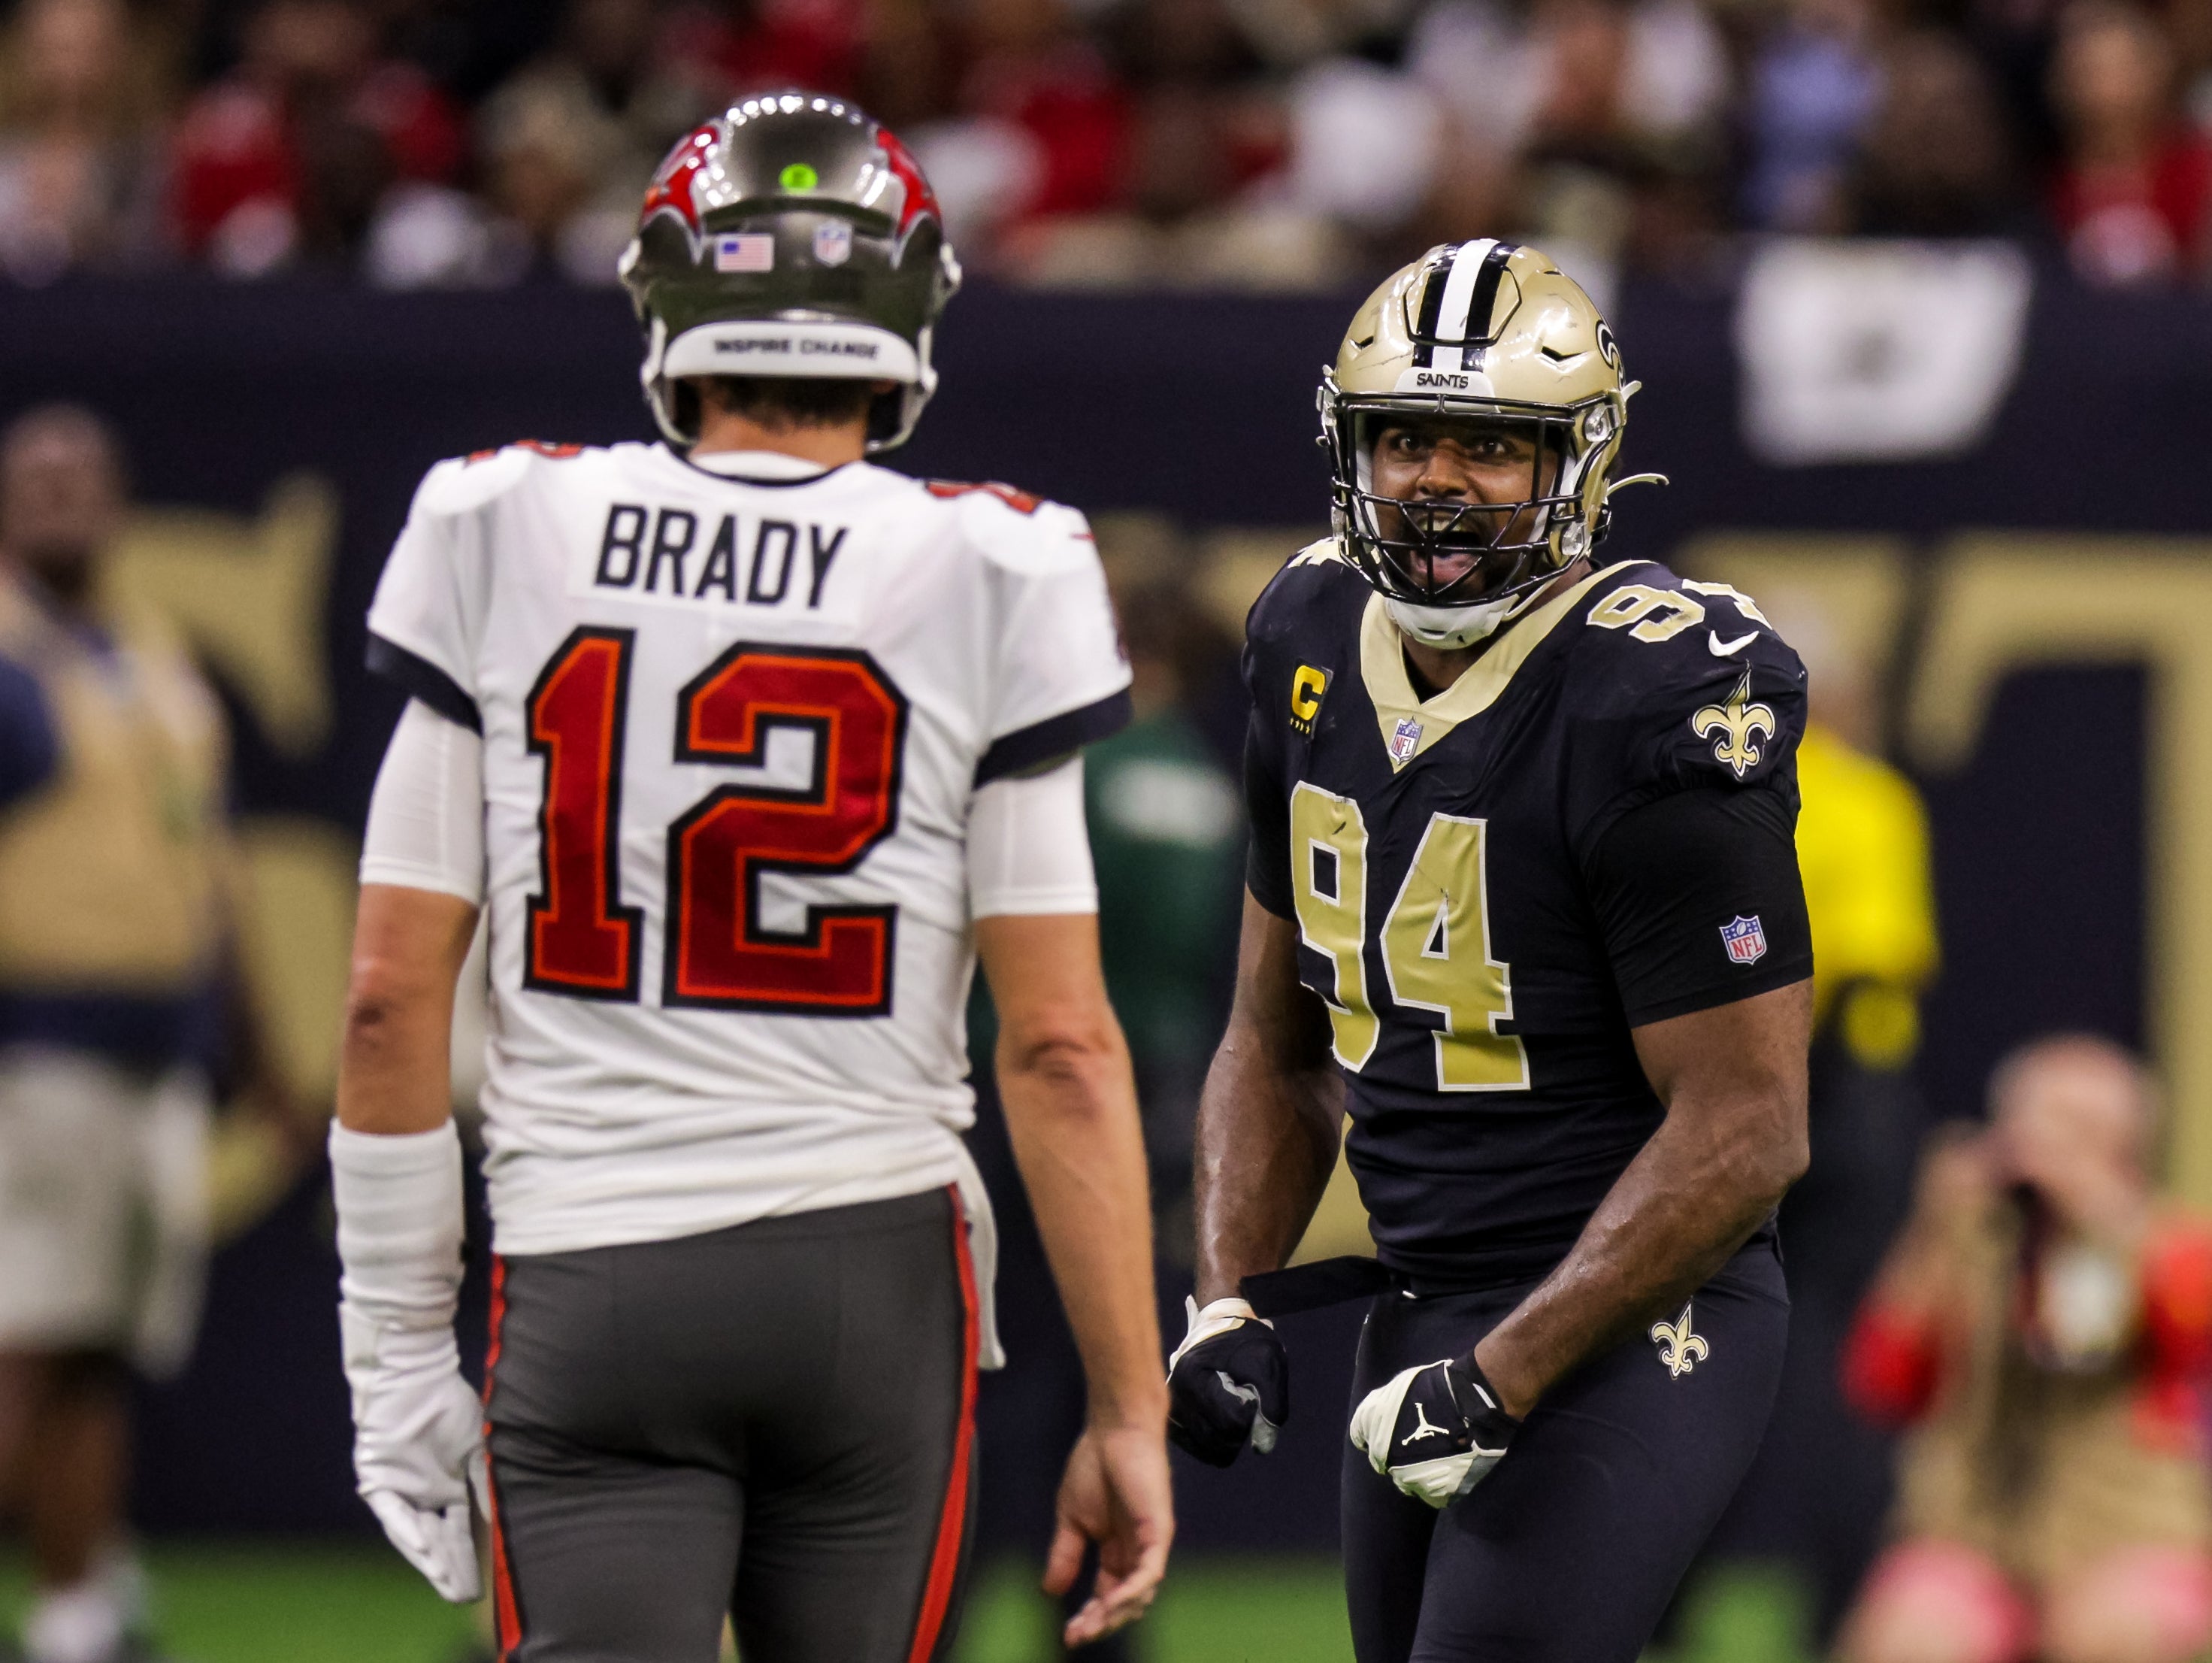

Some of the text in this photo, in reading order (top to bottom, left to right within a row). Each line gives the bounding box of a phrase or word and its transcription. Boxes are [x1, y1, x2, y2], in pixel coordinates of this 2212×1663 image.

[715, 339, 879, 359] INSPIRE CHANGE
[1417, 373, 1469, 389] SAINTS
[595, 503, 849, 607] BRADY
[1291, 665, 1325, 721] C
[1393, 736, 1413, 755] NFL
[523, 626, 909, 1018] 12
[1291, 780, 1530, 1092] 94
[1731, 934, 1763, 958] NFL
